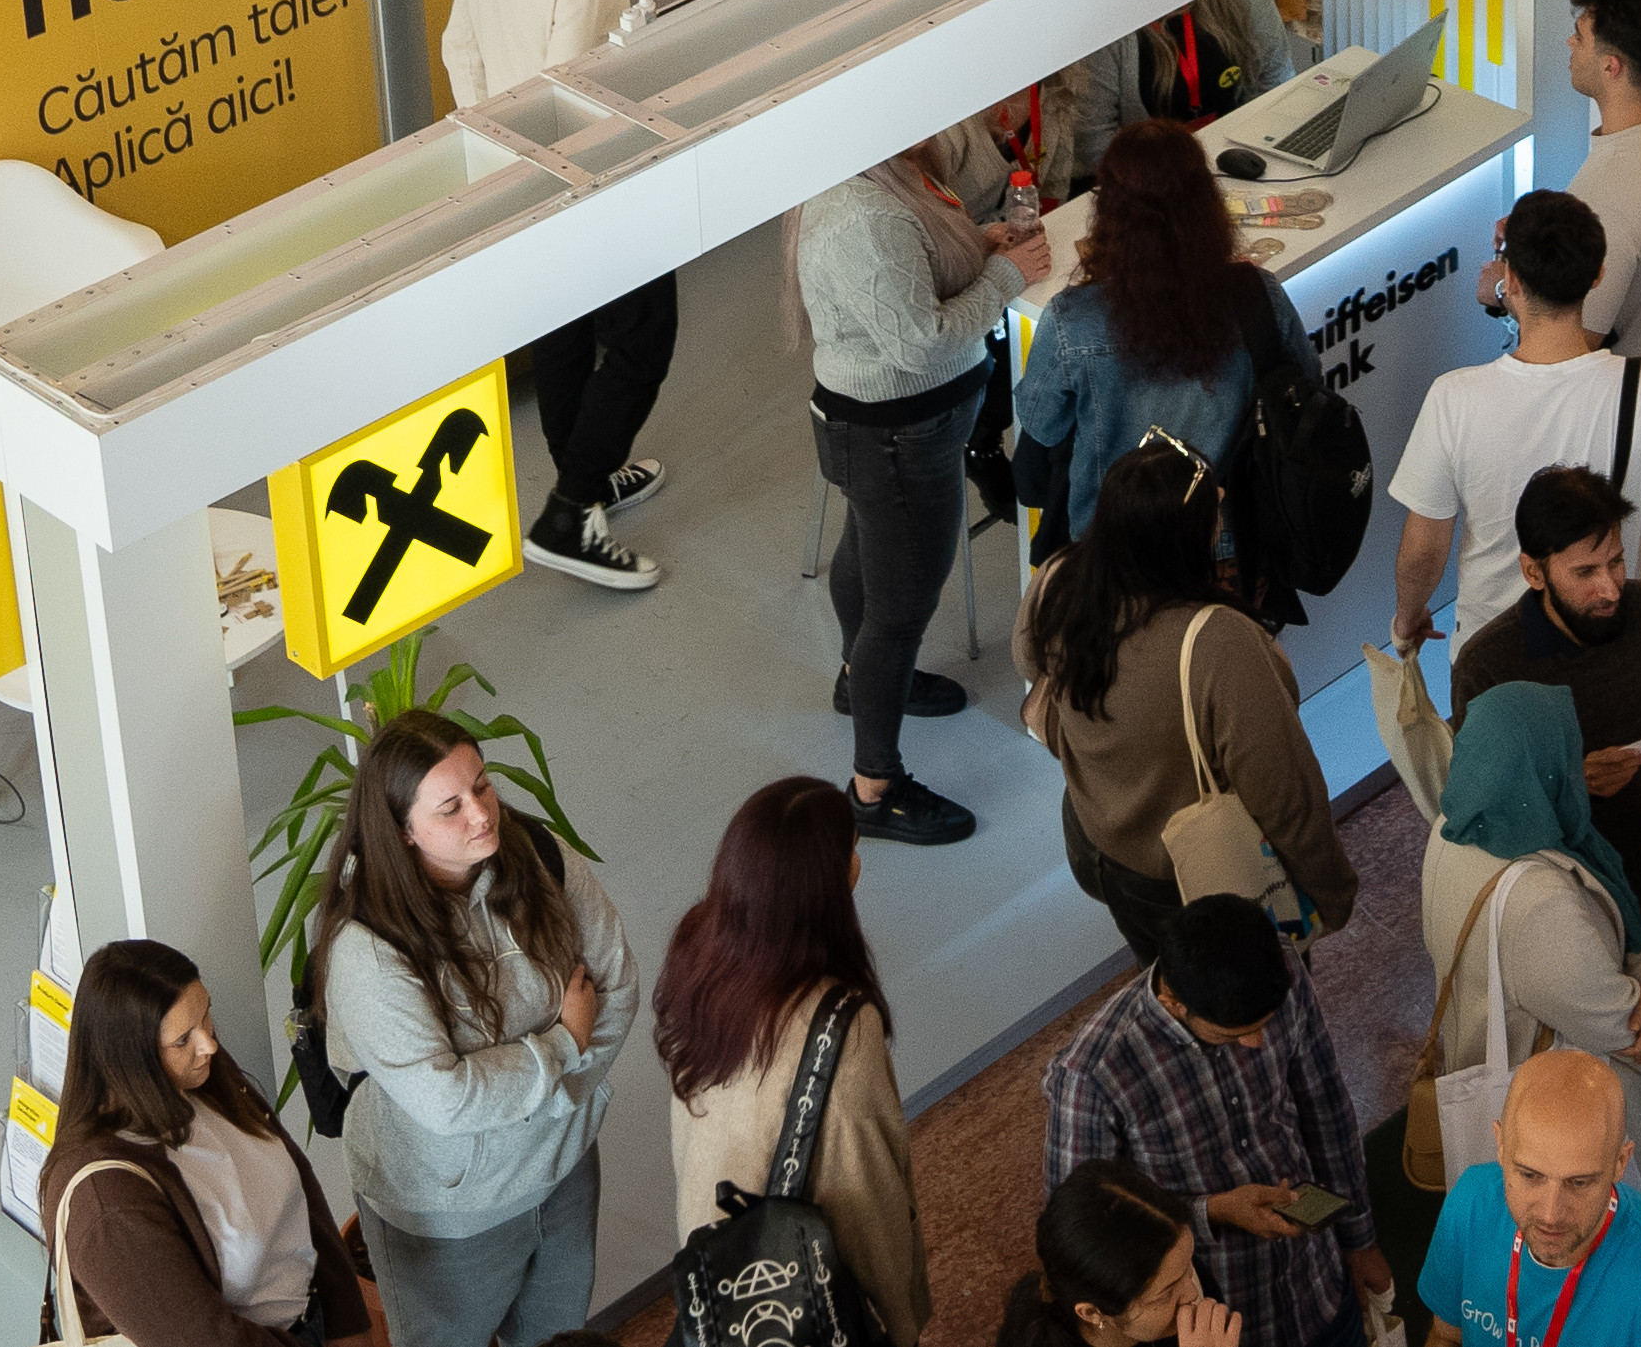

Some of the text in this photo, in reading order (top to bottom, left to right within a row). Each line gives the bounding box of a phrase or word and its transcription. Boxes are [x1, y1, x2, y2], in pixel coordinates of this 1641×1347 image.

[38, 24, 237, 136] Căutăm
[52, 56, 297, 205] Aplică aici!
